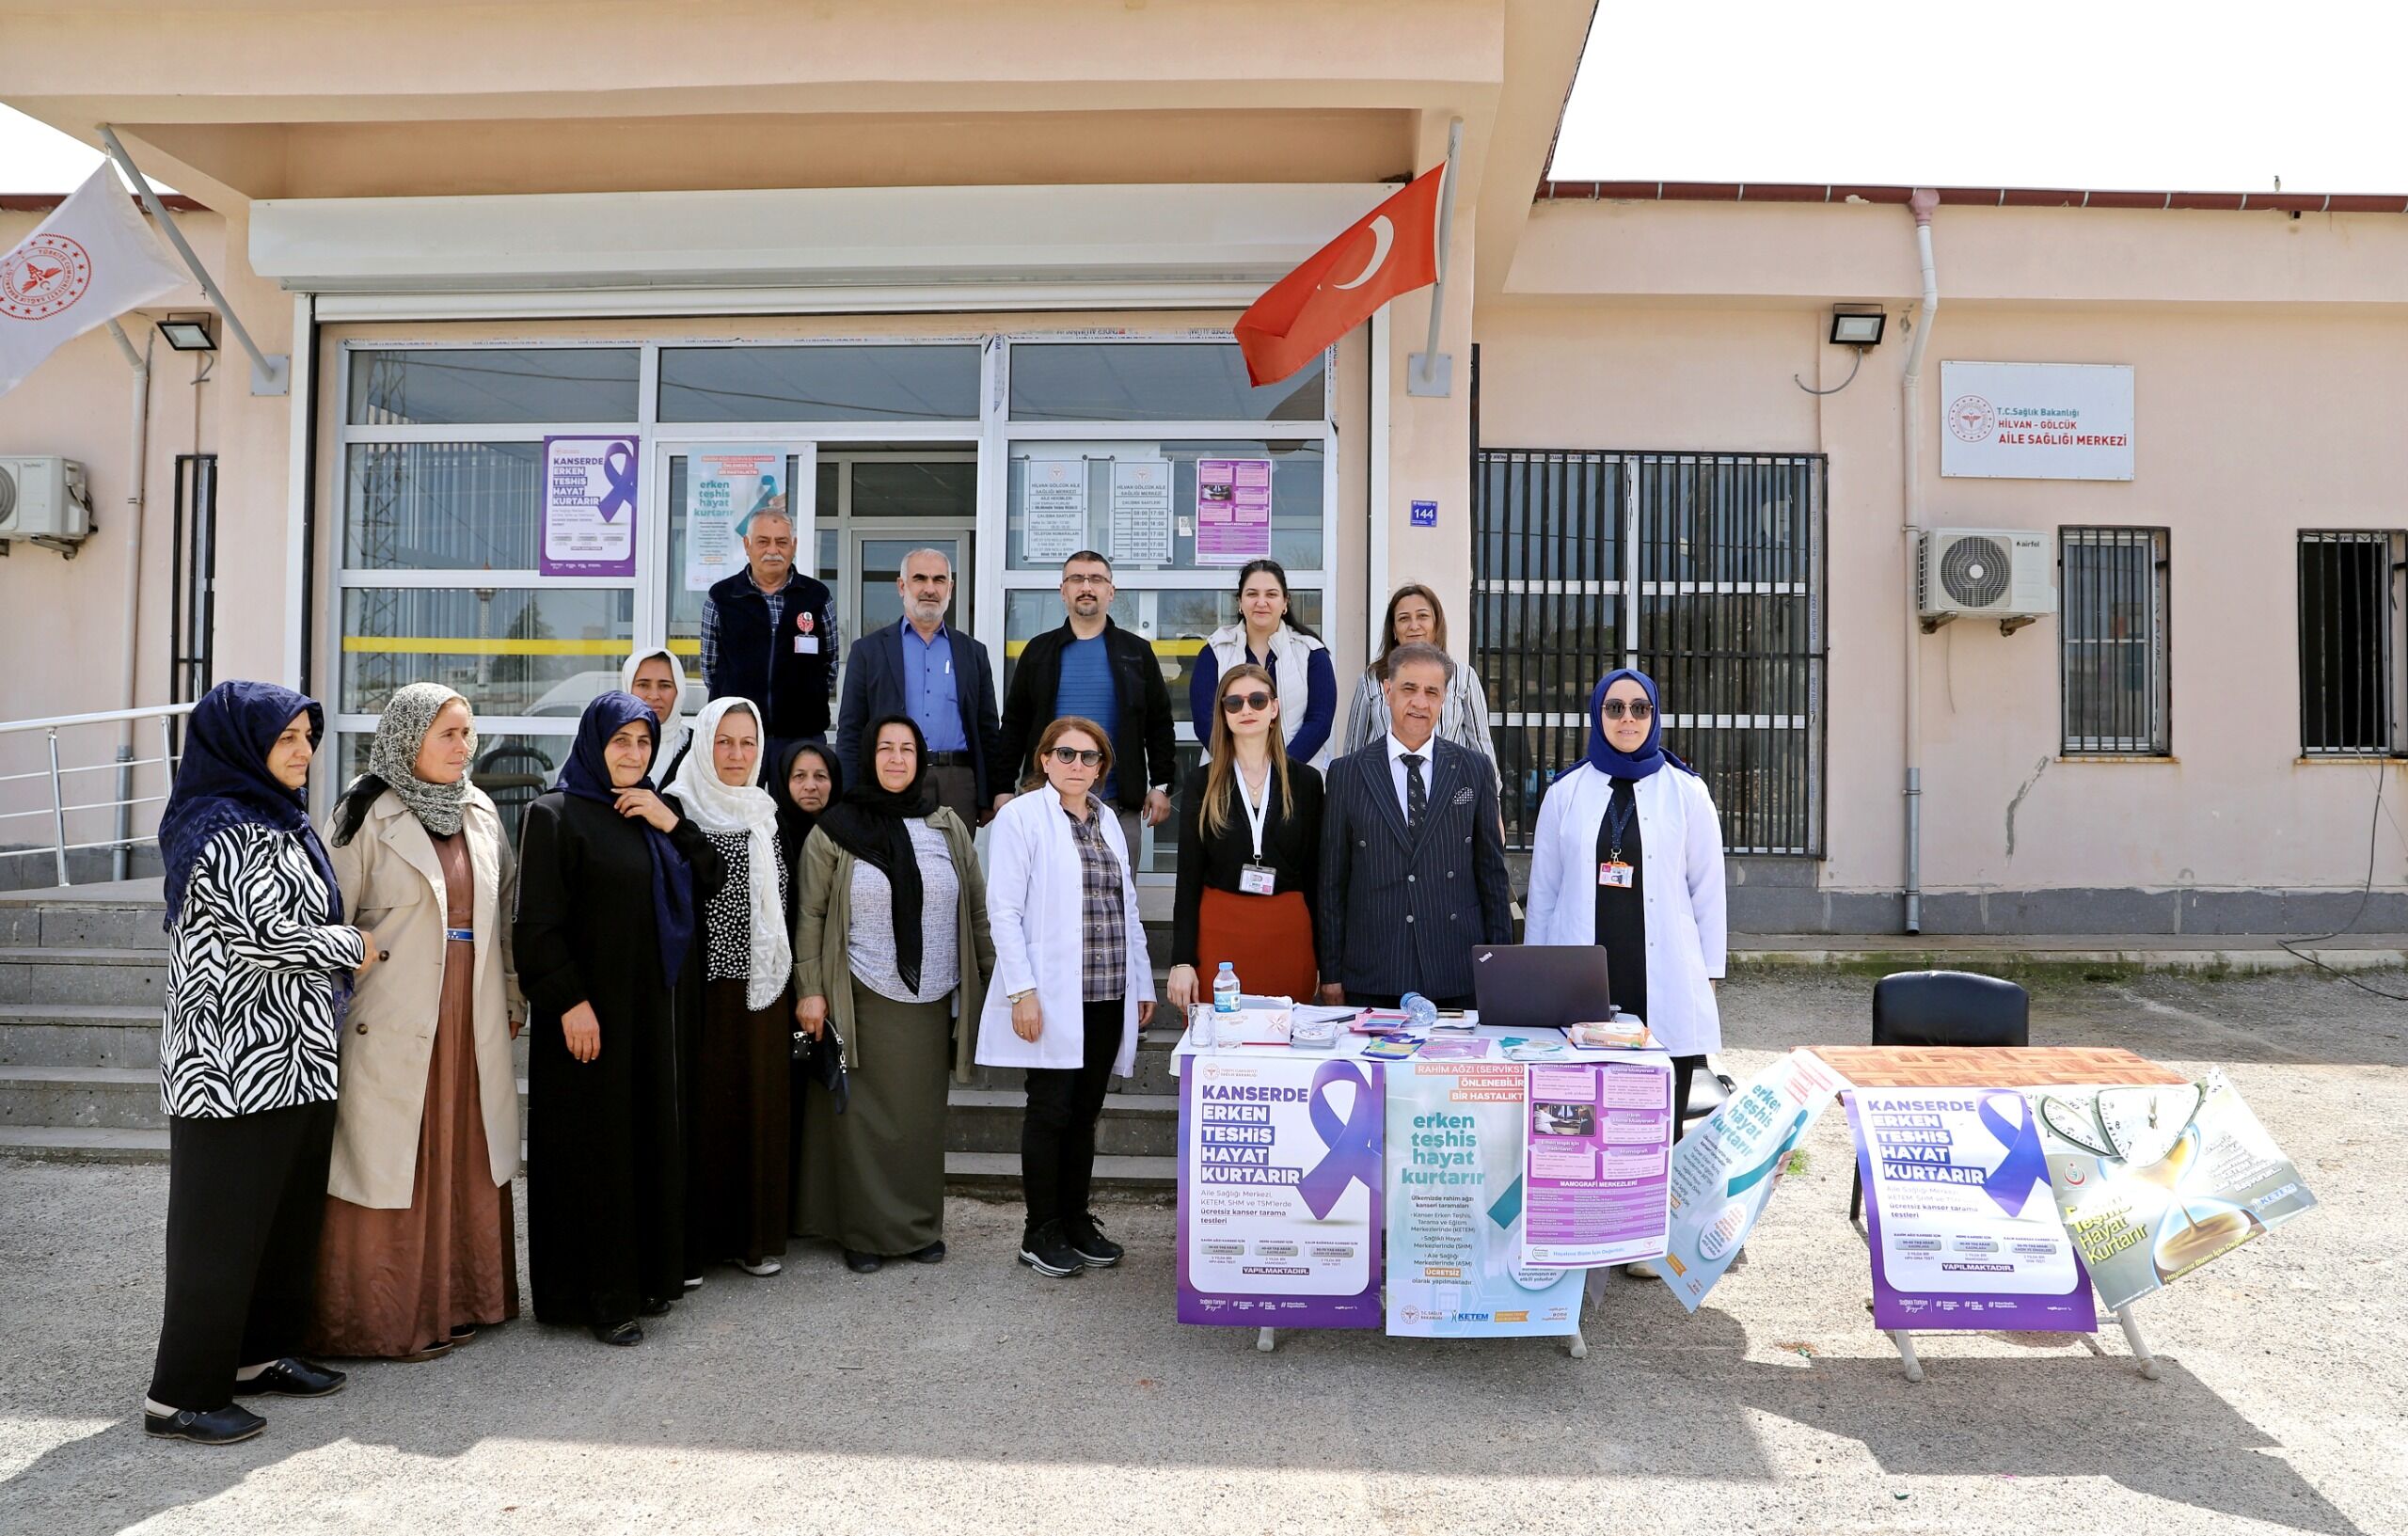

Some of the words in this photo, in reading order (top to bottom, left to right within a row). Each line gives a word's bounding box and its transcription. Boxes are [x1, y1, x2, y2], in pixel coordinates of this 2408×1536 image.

[1997, 407, 2039, 418] T.C.Sağlık
[2041, 408, 2080, 418] Bakanlığı
[1998, 419, 2033, 429] HİLVAN
[2040, 419, 2077, 430] GÖLCÜK
[1998, 431, 2025, 444] AİLE
[2027, 432, 2073, 446] SAĞLIĞI
[2077, 434, 2127, 447] MERKEZİ
[553, 457, 604, 466] KANSERDE
[553, 487, 584, 496] HAYAT
[700, 480, 730, 489] erken
[553, 497, 600, 505] KURTARIR
[699, 489, 730, 499] teşhis
[699, 499, 730, 509] hayat
[694, 509, 734, 517] kurtarır
[1415, 508, 1434, 519] 144
[1418, 1064, 1450, 1073] RAHİM
[1451, 1064, 1474, 1073] AĞZI
[1476, 1064, 1524, 1074] (SERVİKS)
[1461, 1077, 1524, 1087] ÖNLENEBİLİR
[1202, 1085, 1308, 1102] KANSERDE
[1451, 1090, 1468, 1101] BİR
[1751, 1084, 1782, 1114] erken
[1203, 1104, 1267, 1122] ERKEN
[1738, 1094, 1773, 1128] teşhis
[1867, 1101, 1976, 1112] KANSERDE
[1413, 1112, 1475, 1129] erken
[1727, 1104, 1763, 1141] hayat
[1874, 1115, 1941, 1128] ERKEN
[1411, 1130, 1477, 1148] teşhis
[1710, 1114, 1753, 1158] kurtarır
[1201, 1147, 1268, 1164] HAYAT
[1413, 1148, 1475, 1169] hayat
[1880, 1146, 1948, 1163] HAYAT
[1201, 1166, 1300, 1184] KURTARIR
[1402, 1167, 1485, 1185] kurtarır
[1883, 1164, 1985, 1184] KURTARIR
[1216, 1190, 1241, 1198] Sağlığı
[2259, 1183, 2298, 1205] KETEM
[2078, 1215, 2130, 1250] Hayat
[2085, 1223, 2147, 1265] Kurtarır
[2194, 1253, 2213, 1268] Bizim
[2213, 1247, 2226, 1259] İçin
[1942, 1263, 2014, 1272] YAPILMAKTADIR.
